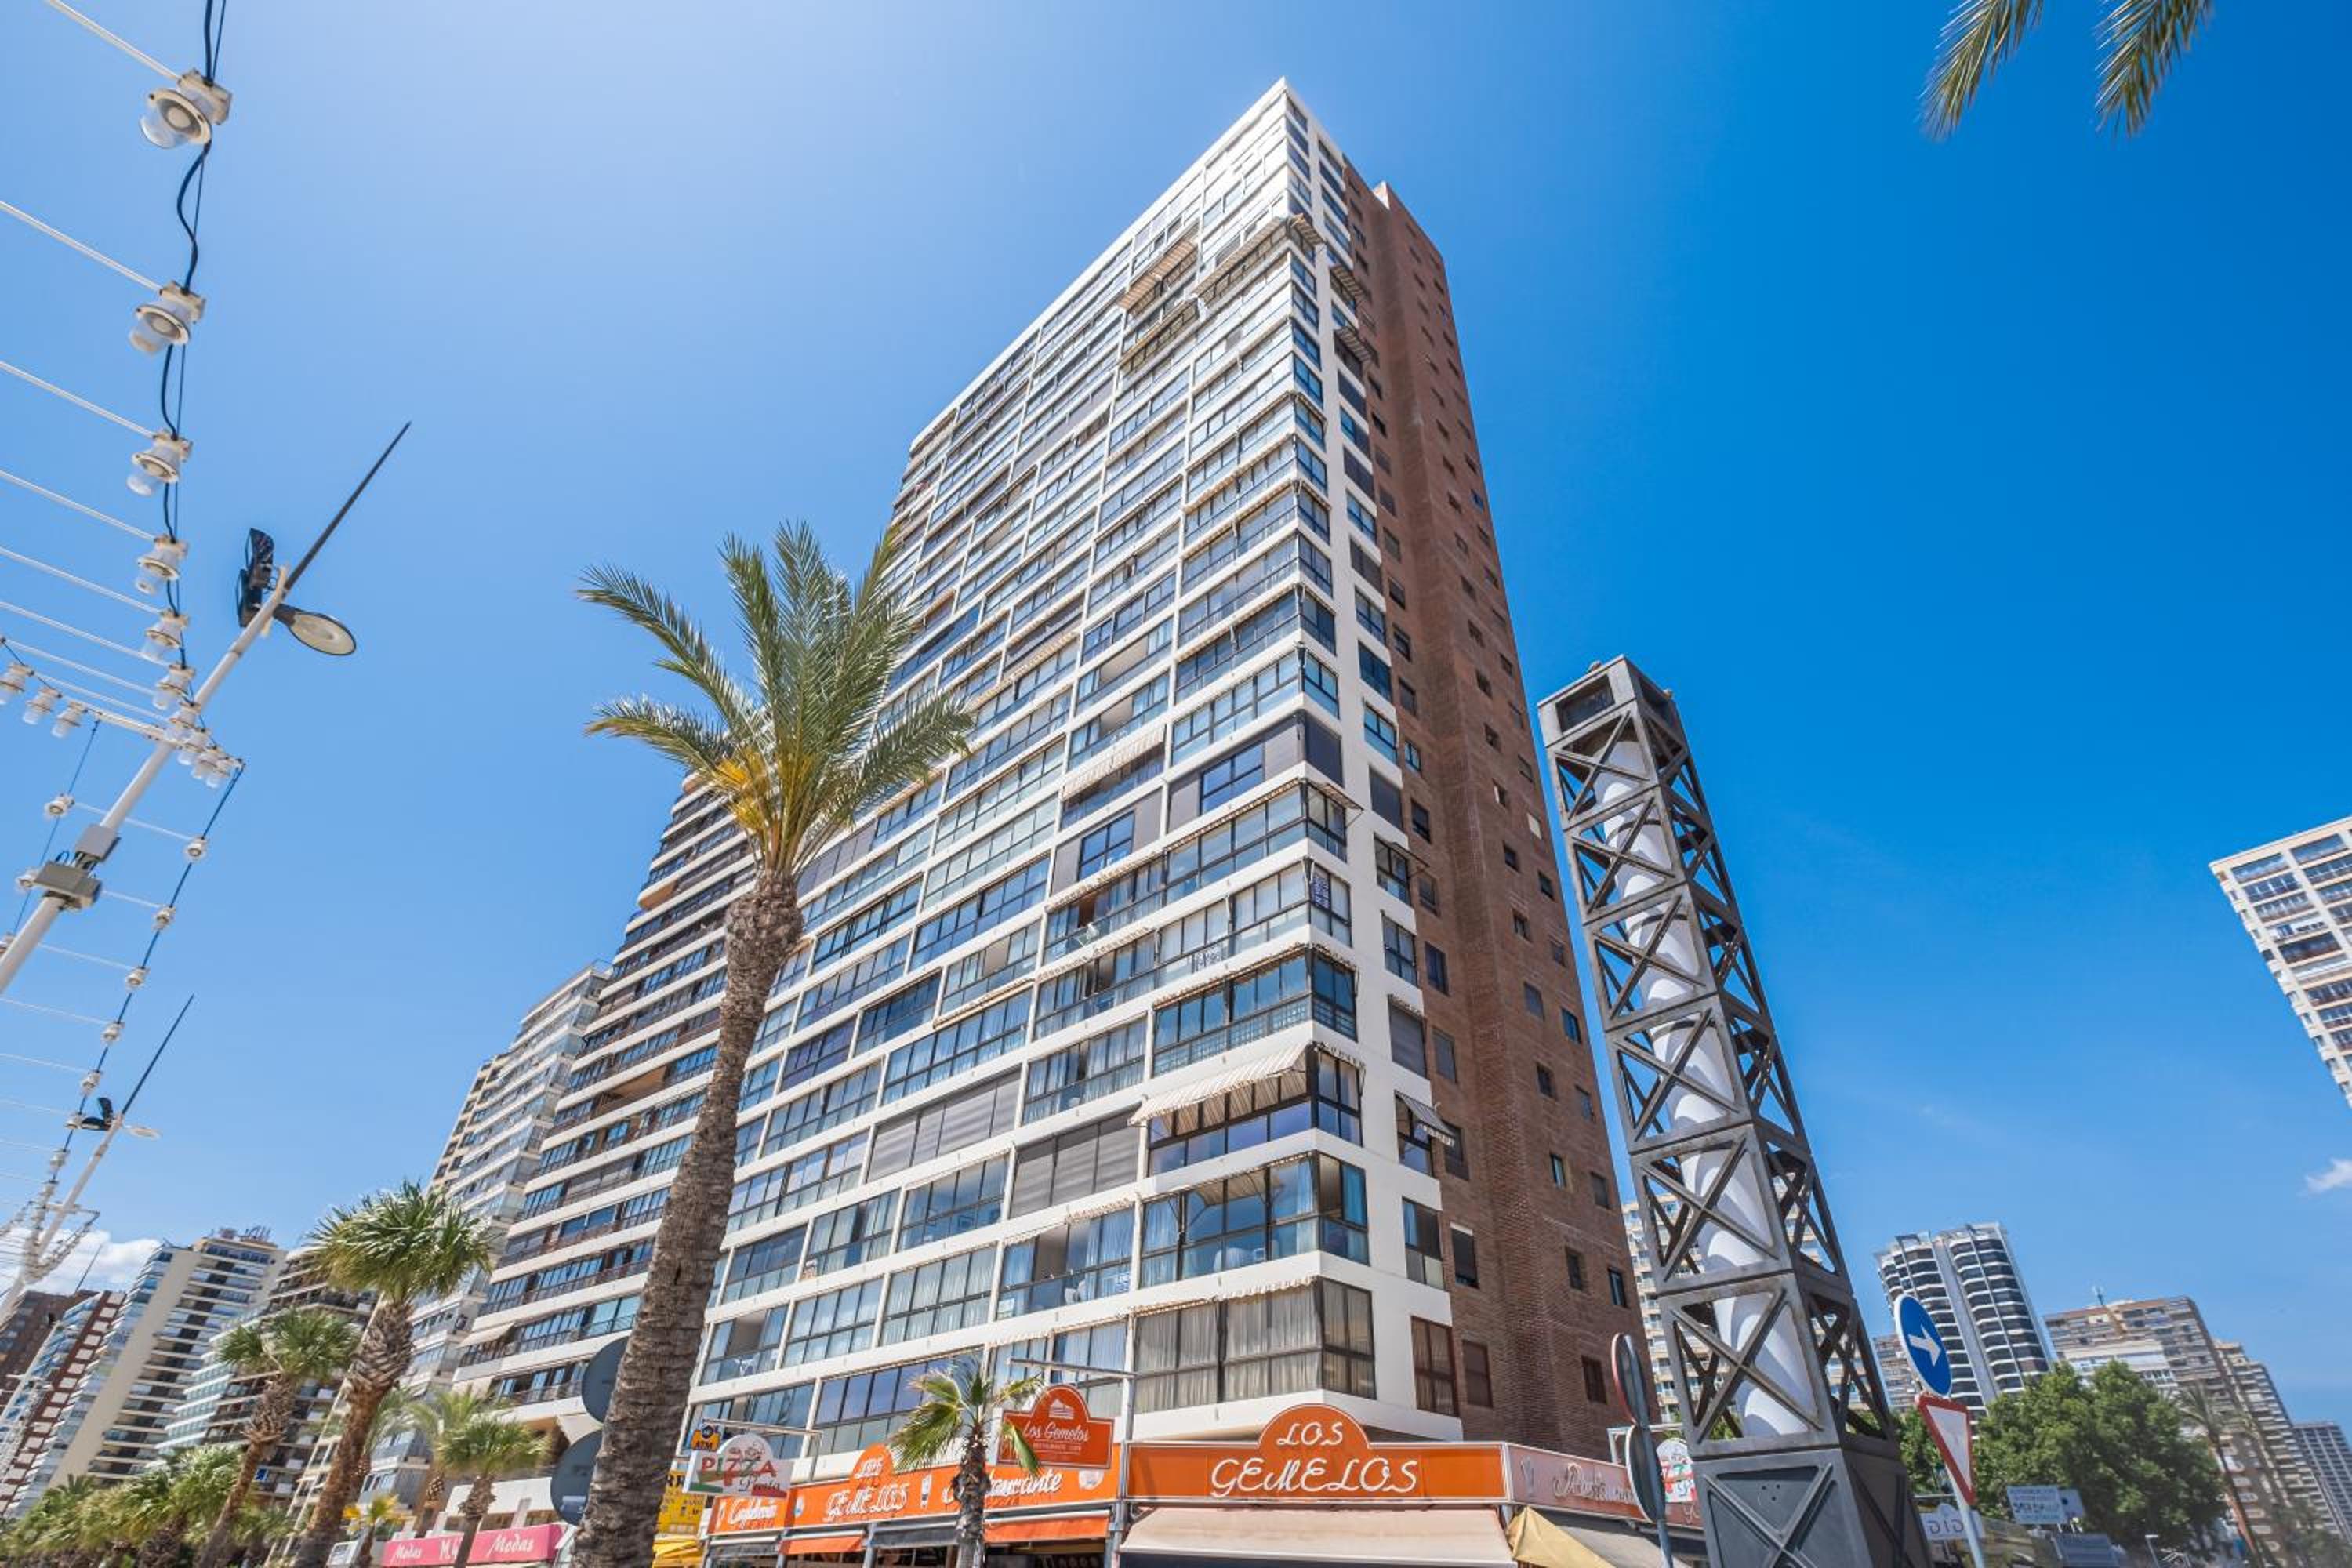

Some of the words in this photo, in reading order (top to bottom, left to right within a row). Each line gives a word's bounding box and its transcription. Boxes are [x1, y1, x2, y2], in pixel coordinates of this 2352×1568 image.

[1276, 1421, 1343, 1446] LOS
[702, 1457, 777, 1477] PIZZA
[1210, 1457, 1418, 1498] GEMELOS
[390, 1543, 422, 1563] Modas
[487, 1533, 535, 1559] Modas
